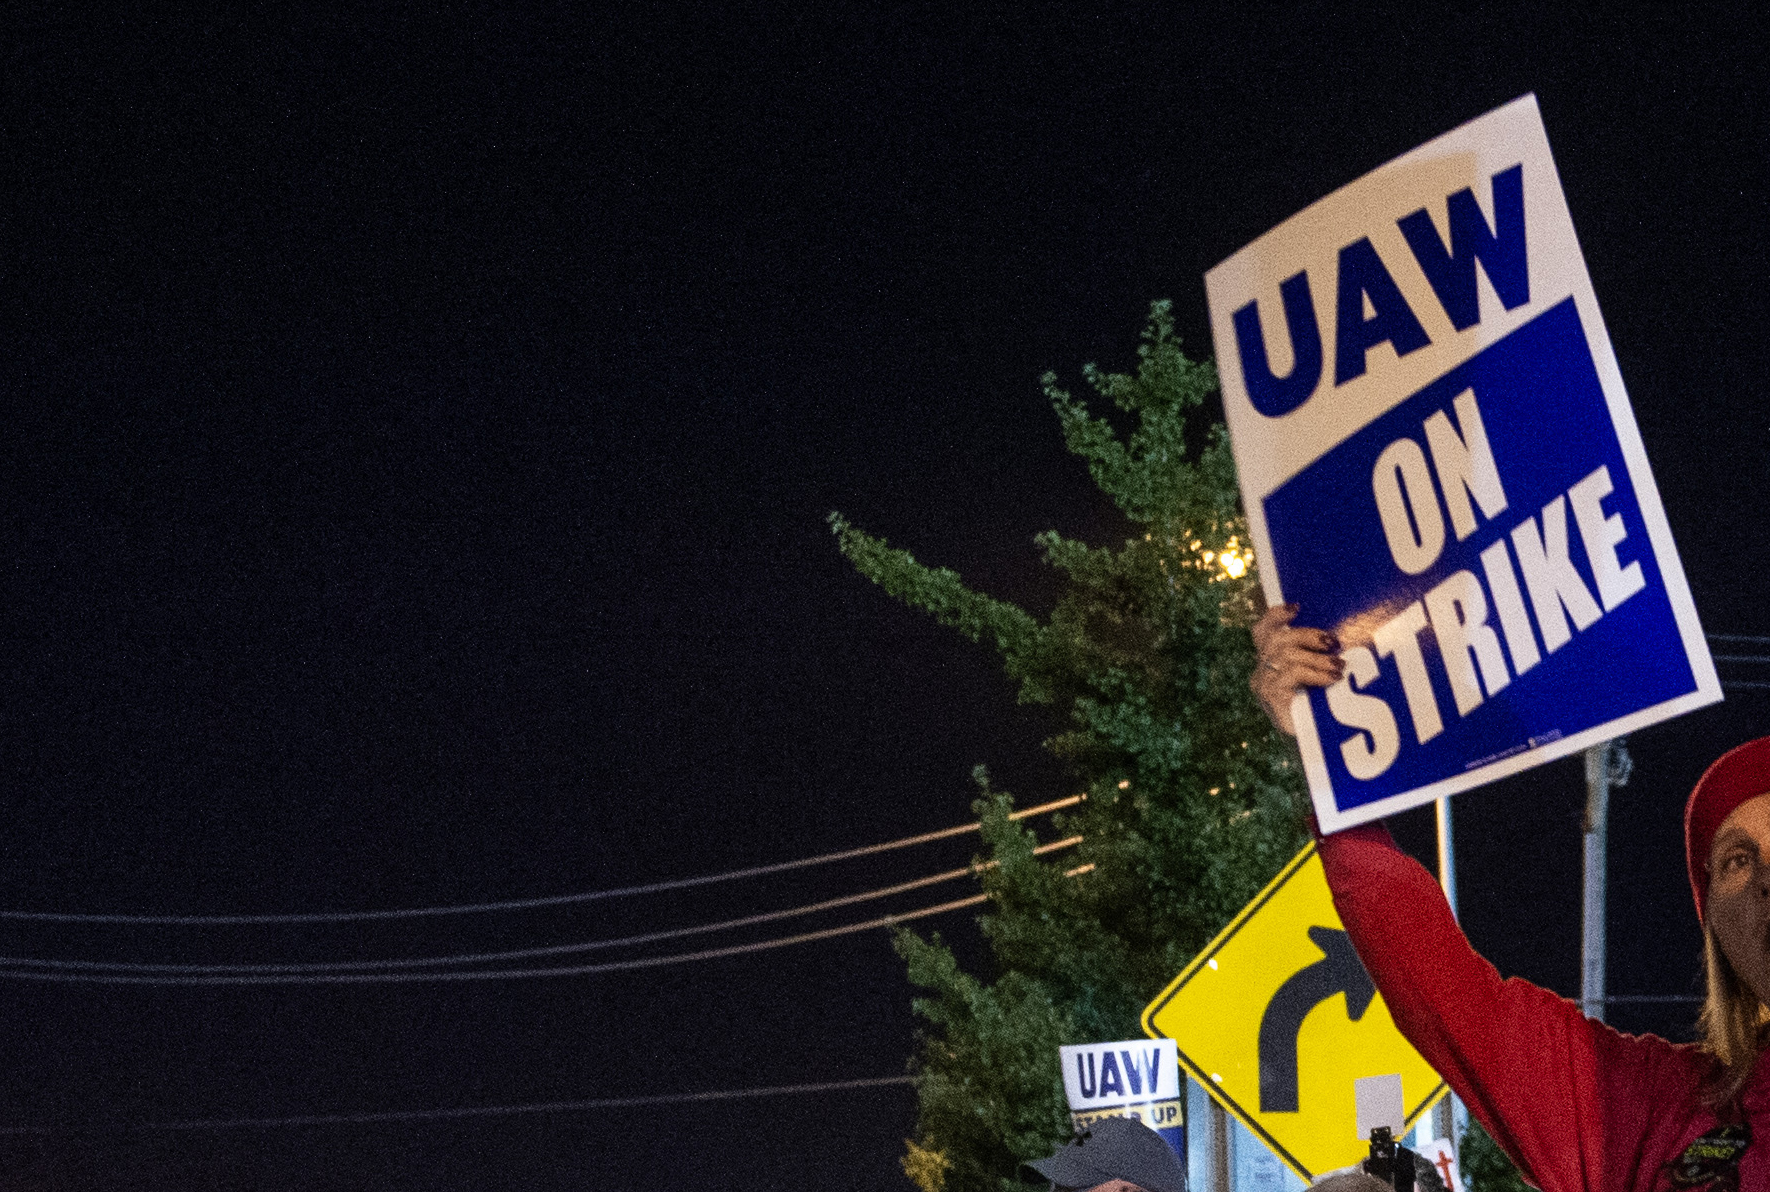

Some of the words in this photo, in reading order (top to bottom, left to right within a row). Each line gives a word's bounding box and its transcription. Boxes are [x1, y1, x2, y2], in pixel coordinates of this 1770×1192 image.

[1231, 162, 1531, 419] UAW
[1371, 385, 1509, 576] ON
[1325, 463, 1648, 782] STRIKE
[1076, 1047, 1161, 1099] UAW
[1151, 1106, 1178, 1125] UP
